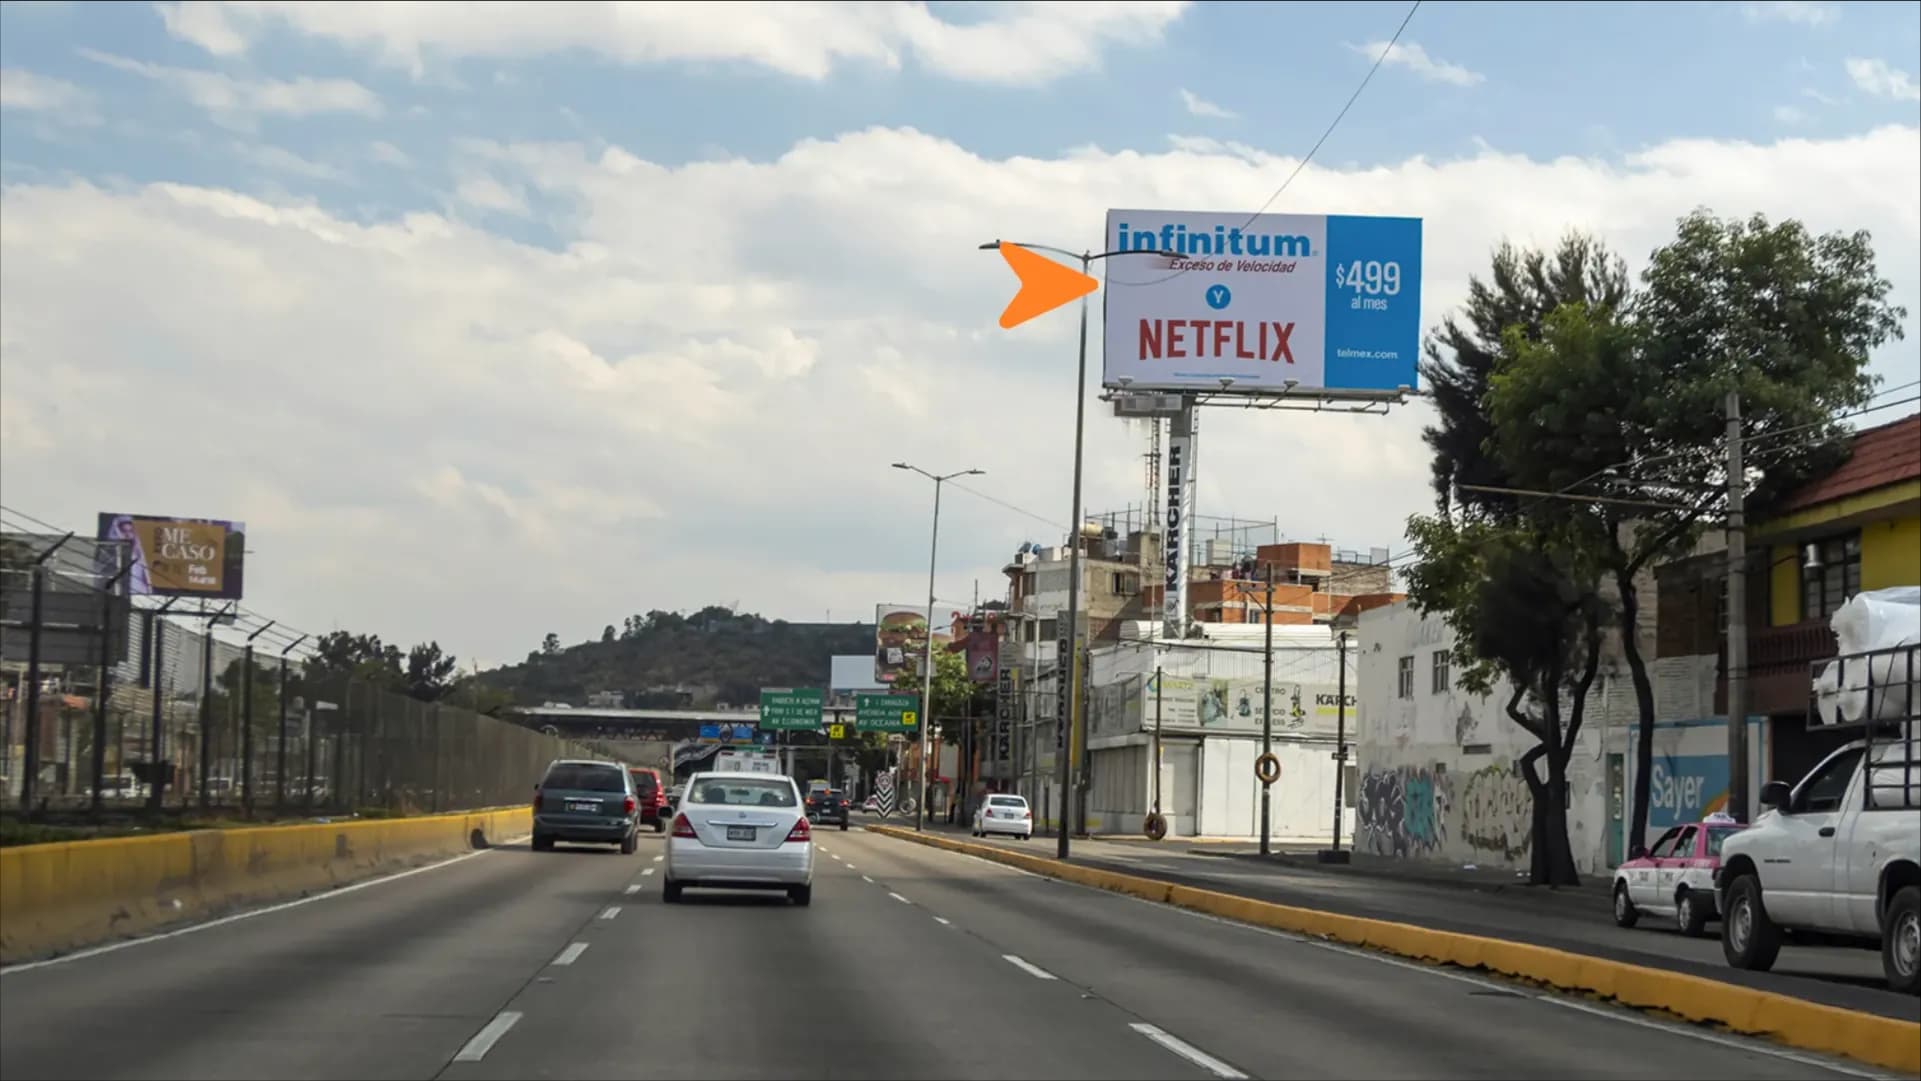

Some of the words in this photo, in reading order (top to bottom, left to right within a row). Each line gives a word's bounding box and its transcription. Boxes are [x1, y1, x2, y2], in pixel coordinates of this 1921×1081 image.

[1119, 223, 1310, 257] infinitum
[1169, 258, 1214, 271] Exceso
[1218, 259, 1232, 271] de
[1236, 260, 1297, 273] Velocidad
[1336, 260, 1400, 295] $499
[1212, 290, 1224, 303] Y
[1351, 296, 1361, 309] al
[1363, 298, 1388, 310] mes
[1139, 319, 1295, 364] NETFLIX
[1337, 348, 1398, 359] telmex.com
[161, 527, 192, 544] ME
[161, 543, 215, 561] CASO
[1652, 764, 1705, 821] Sayer
